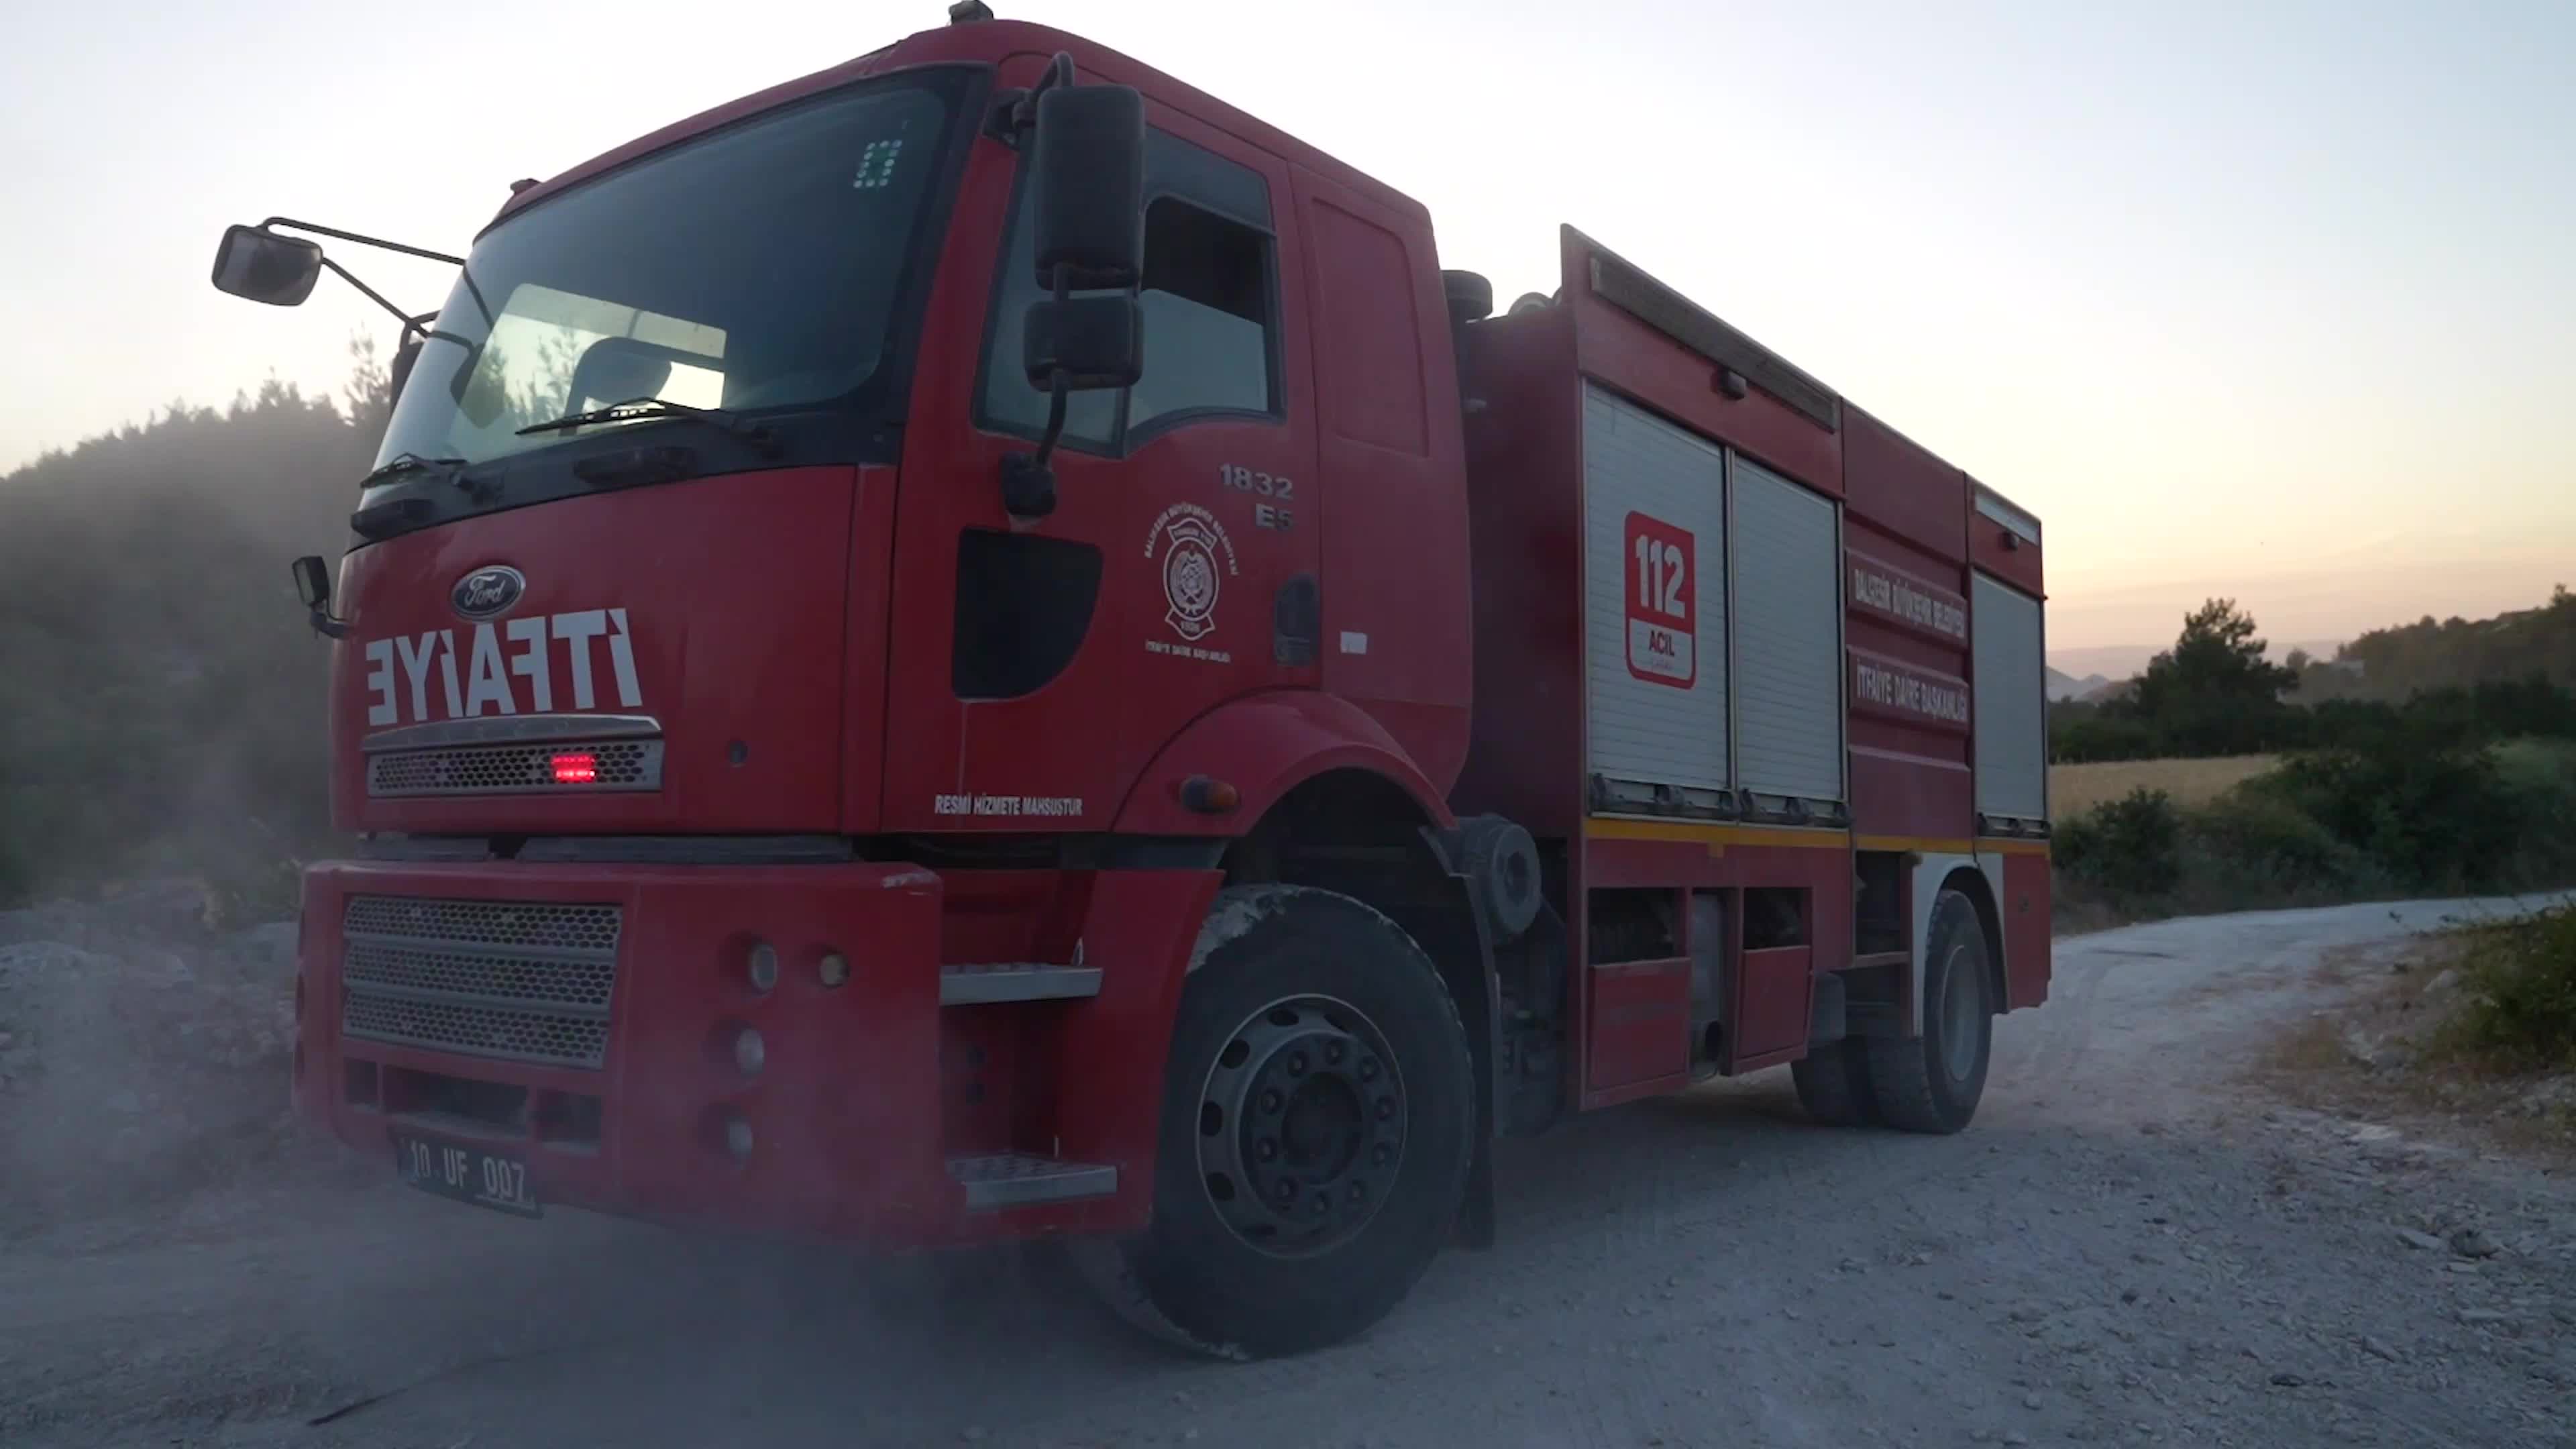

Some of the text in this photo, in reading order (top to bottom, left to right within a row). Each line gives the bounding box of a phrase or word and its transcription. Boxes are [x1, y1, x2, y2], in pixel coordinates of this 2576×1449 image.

[1220, 464, 1294, 499] 1832
[1256, 503, 1293, 529] E5
[463, 574, 505, 606] Ford
[1635, 534, 1686, 619] 112
[934, 791, 972, 814] RESMİ
[443, 1148, 468, 1189] UF
